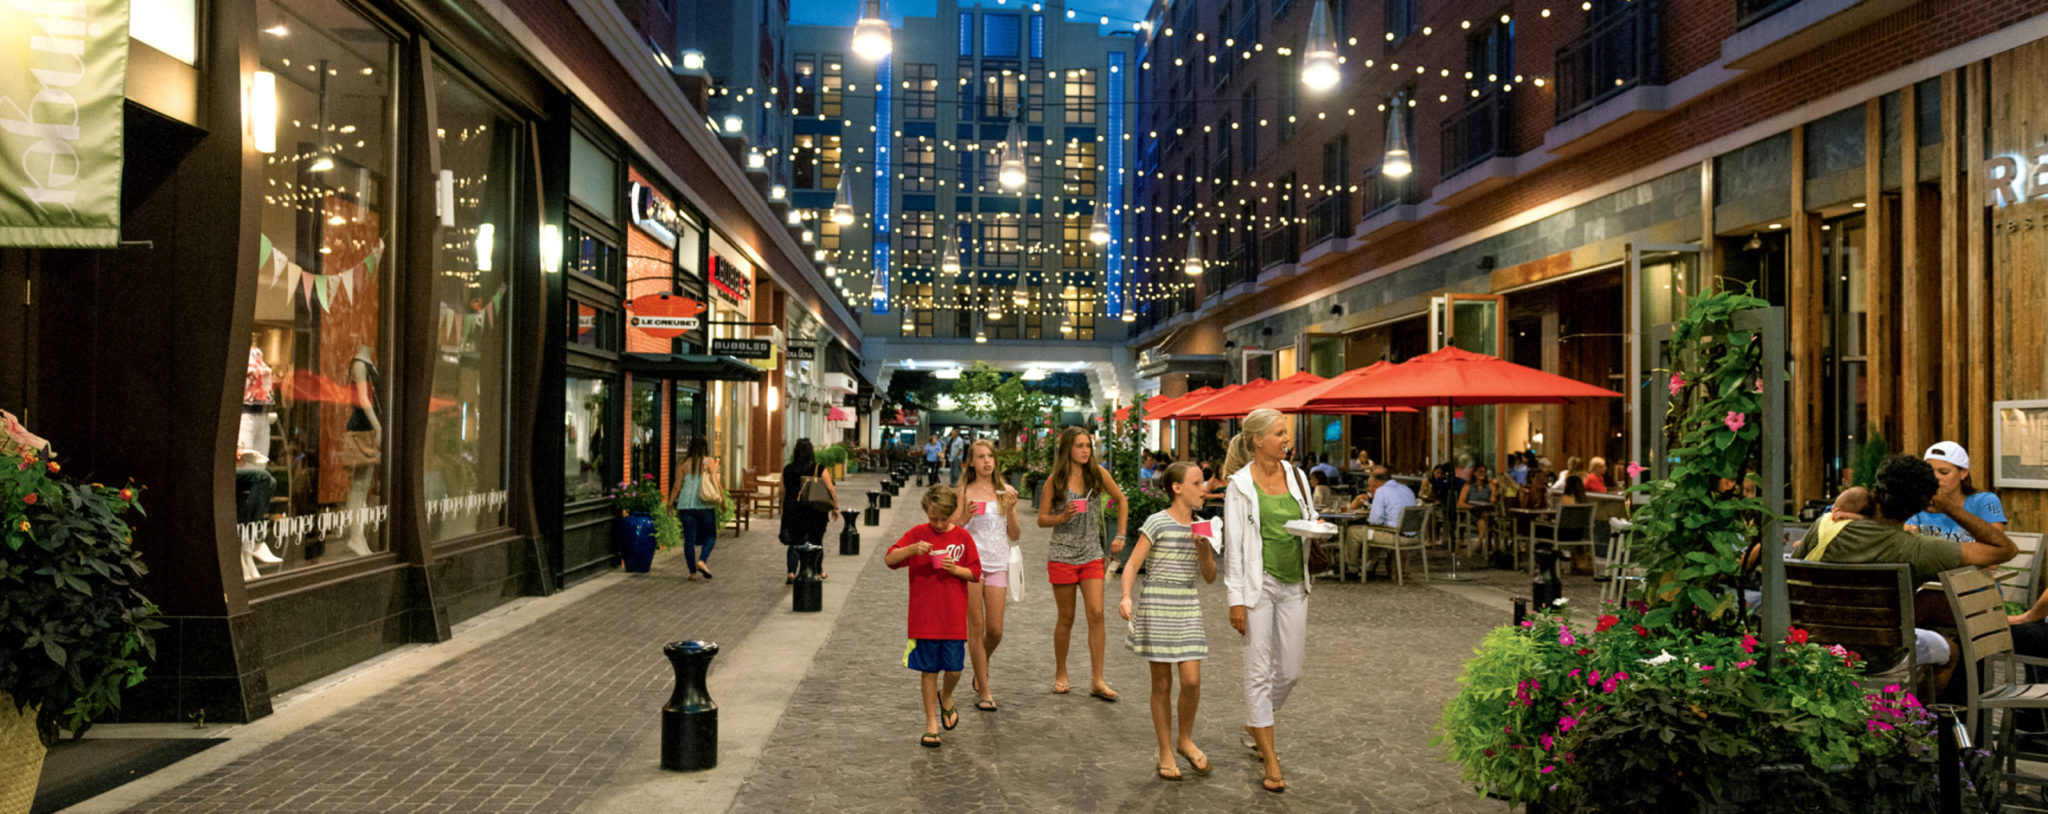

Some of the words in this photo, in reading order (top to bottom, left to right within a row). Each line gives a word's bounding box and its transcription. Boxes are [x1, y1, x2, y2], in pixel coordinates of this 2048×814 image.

[714, 341, 768, 351] BUBBLES
[273, 511, 315, 550] ginger
[317, 506, 353, 542] ginger
[356, 502, 388, 532] ginger
